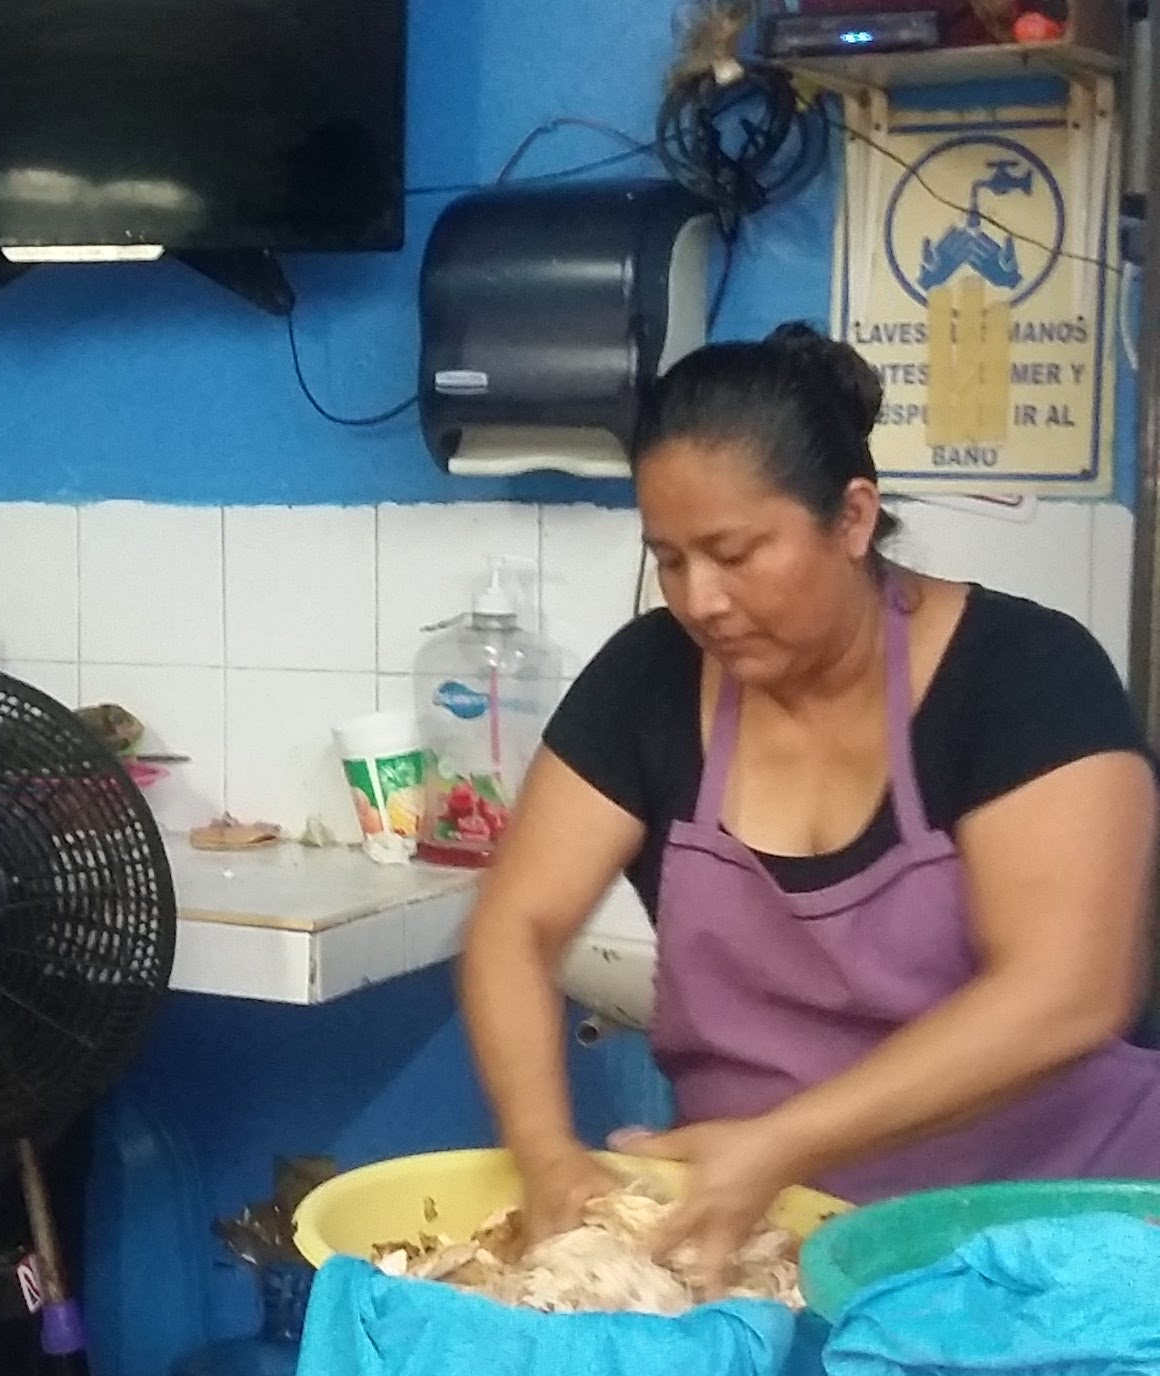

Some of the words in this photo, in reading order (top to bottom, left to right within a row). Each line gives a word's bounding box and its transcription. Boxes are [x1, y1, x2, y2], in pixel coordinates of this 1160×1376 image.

[1071, 363, 1086, 384] Y
[1013, 404, 1038, 425] IR
[1045, 404, 1075, 426] AL
